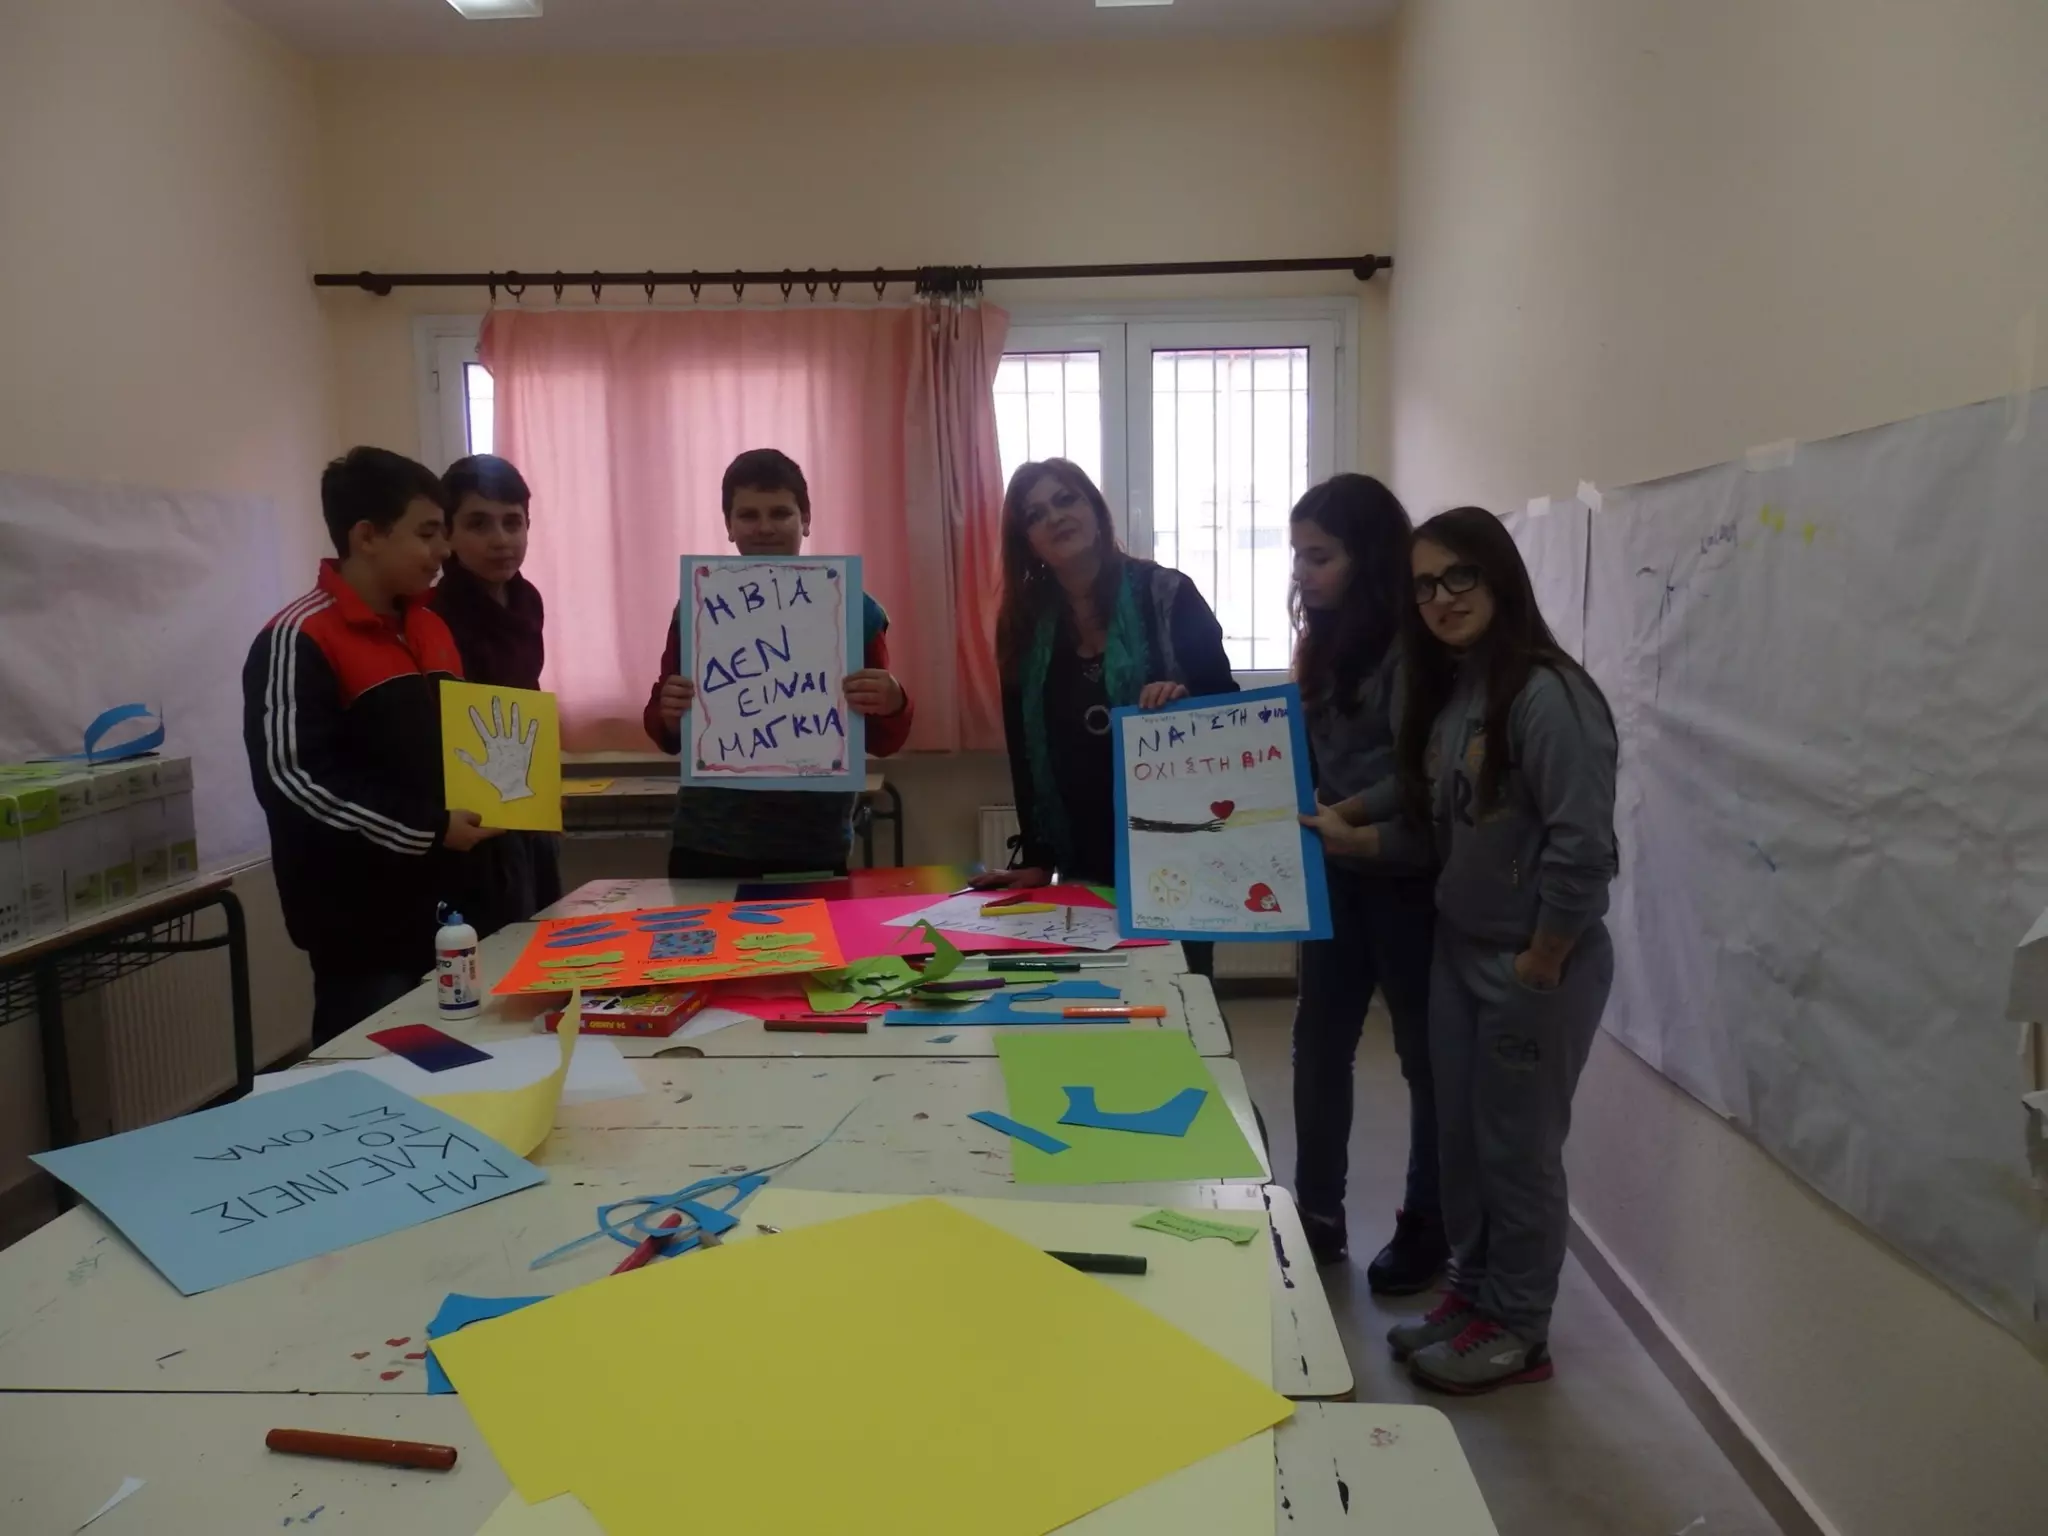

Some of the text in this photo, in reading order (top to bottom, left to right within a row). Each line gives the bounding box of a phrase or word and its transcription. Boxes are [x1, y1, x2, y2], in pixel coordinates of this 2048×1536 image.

[704, 594, 735, 625] Η
[703, 624, 791, 693] ΔΕΝ
[738, 671, 828, 717] ΕΙΝΑΙ
[718, 706, 845, 761] ΜΑΓΚΙΑ
[1138, 720, 1197, 757] ΝΑΙ
[1211, 708, 1248, 730] ΣΤΗ
[1134, 745, 1282, 781] ΟΧΙ ΣΤΗ ΒΙΑ
[194, 1105, 405, 1162] ΣΤΟΜΑ
[357, 1125, 441, 1148] ΤΟ
[191, 1132, 480, 1234] ΚΛΕΙΝΕΙΣ
[407, 1159, 510, 1203] ΜΗ
